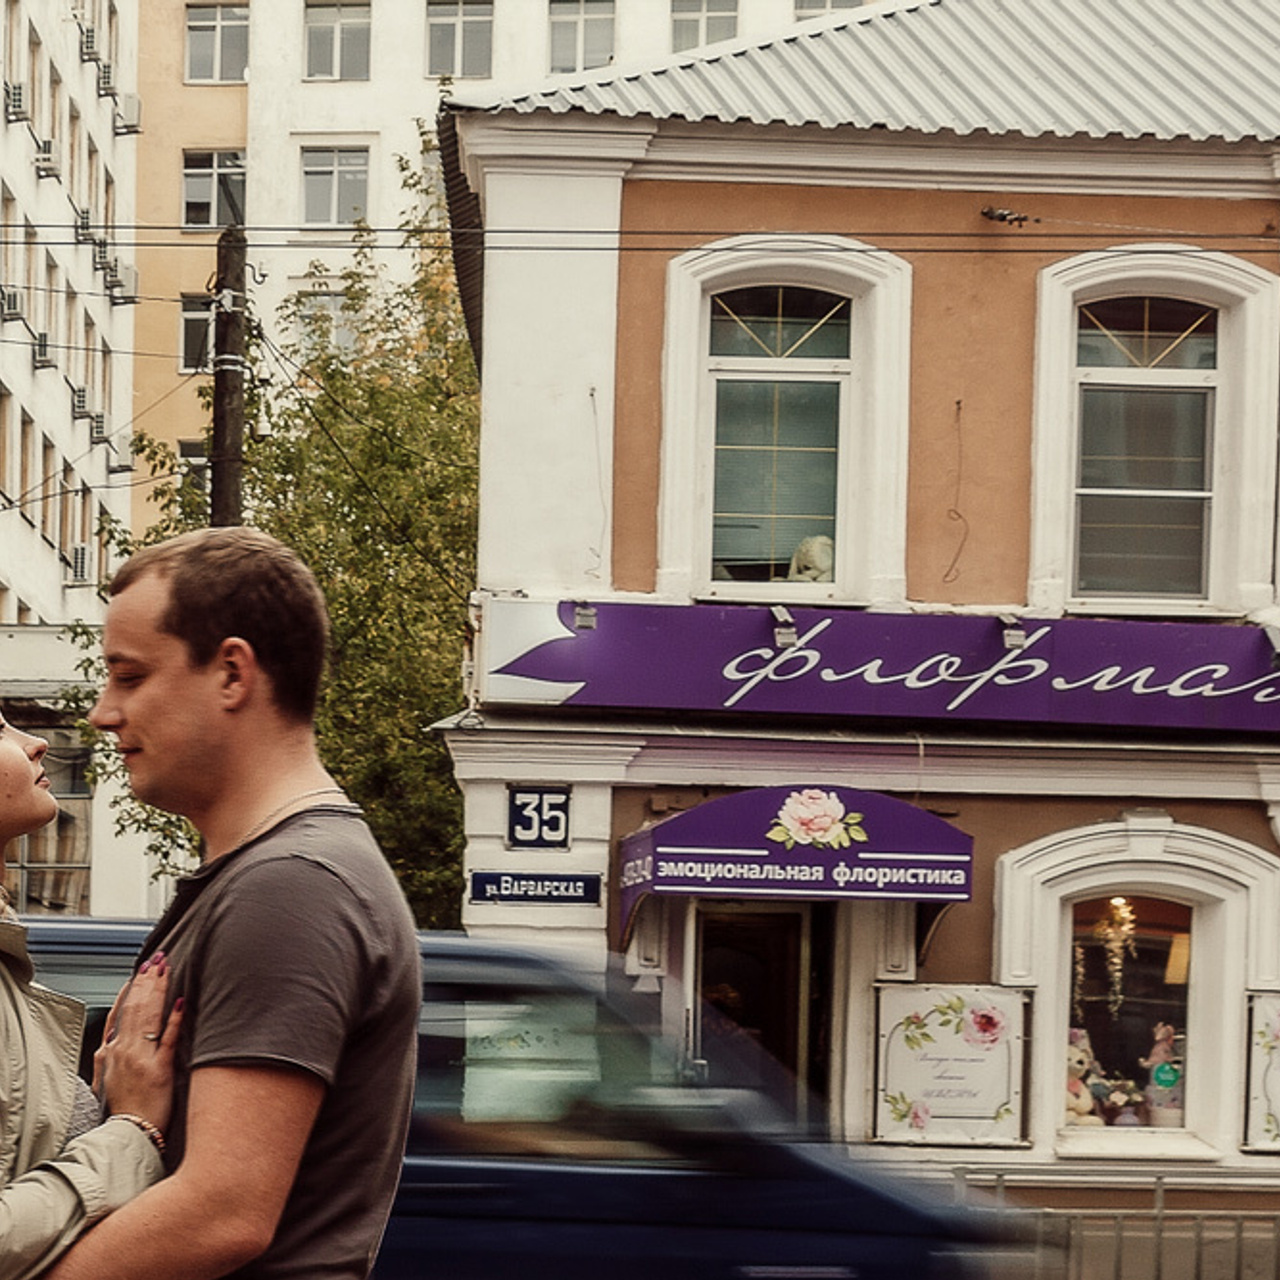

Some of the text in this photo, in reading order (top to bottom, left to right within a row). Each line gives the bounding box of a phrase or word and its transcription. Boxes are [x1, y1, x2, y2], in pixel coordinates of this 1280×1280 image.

[514, 792, 567, 841] 35
[657, 861, 824, 882] эмоциональная
[832, 861, 966, 888] флористика
